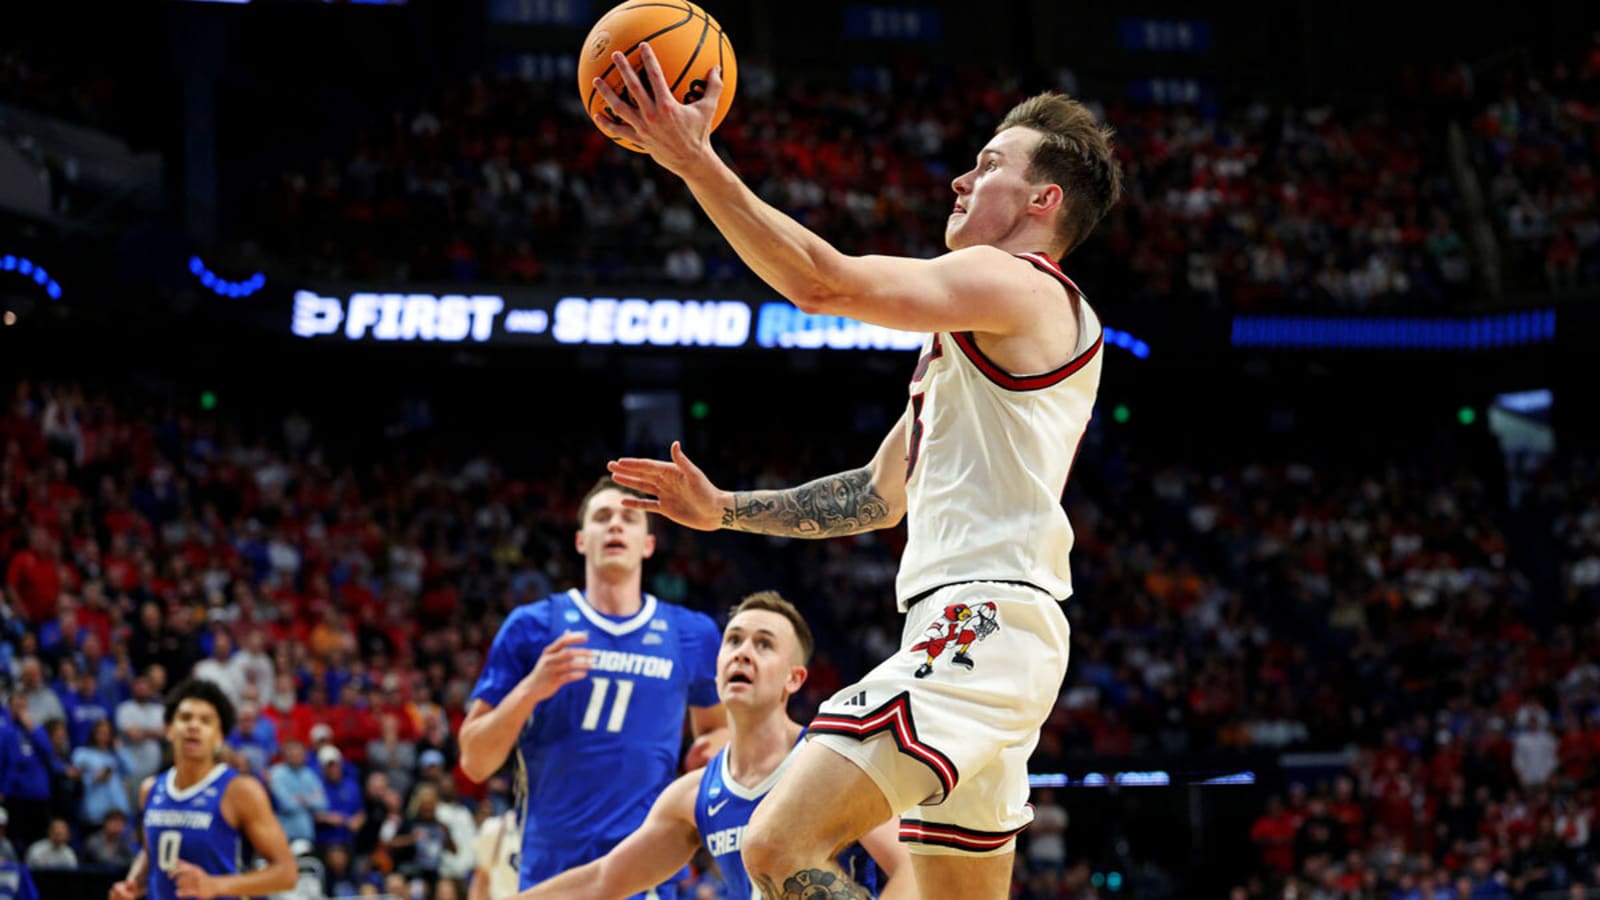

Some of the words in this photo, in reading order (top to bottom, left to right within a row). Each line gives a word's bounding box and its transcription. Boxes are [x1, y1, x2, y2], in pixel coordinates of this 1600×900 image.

[344, 293, 504, 342] FIRST
[552, 297, 750, 347] SECOND
[589, 648, 674, 680] EIGHTON
[581, 677, 634, 733] 11
[158, 829, 182, 873] 0
[706, 824, 749, 857] CREI
